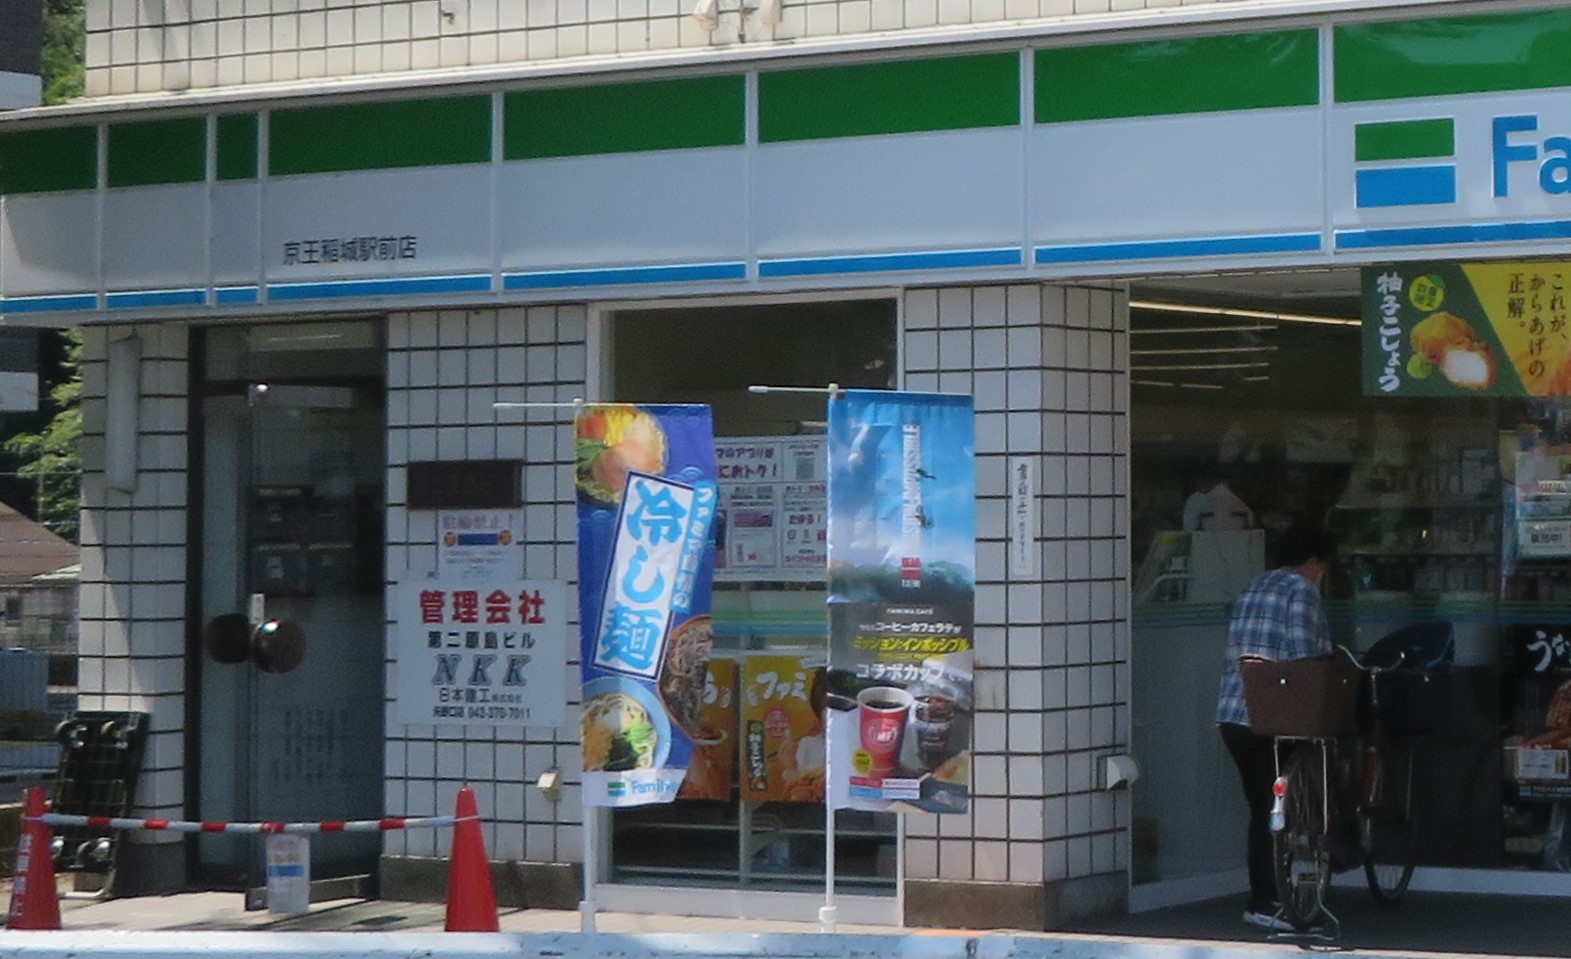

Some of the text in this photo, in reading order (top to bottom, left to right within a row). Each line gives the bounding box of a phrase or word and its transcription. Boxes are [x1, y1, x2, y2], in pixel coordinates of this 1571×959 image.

[283, 236, 417, 265] 京王稲城駅前店
[1507, 272, 1526, 328] 正解。
[1529, 275, 1546, 377] からあげの
[1550, 273, 1567, 340] これが、
[1377, 272, 1403, 392] 柚子こしょう
[602, 479, 688, 670] 冷し麺
[419, 590, 545, 624] 管理会社
[432, 654, 531, 687] NKK
